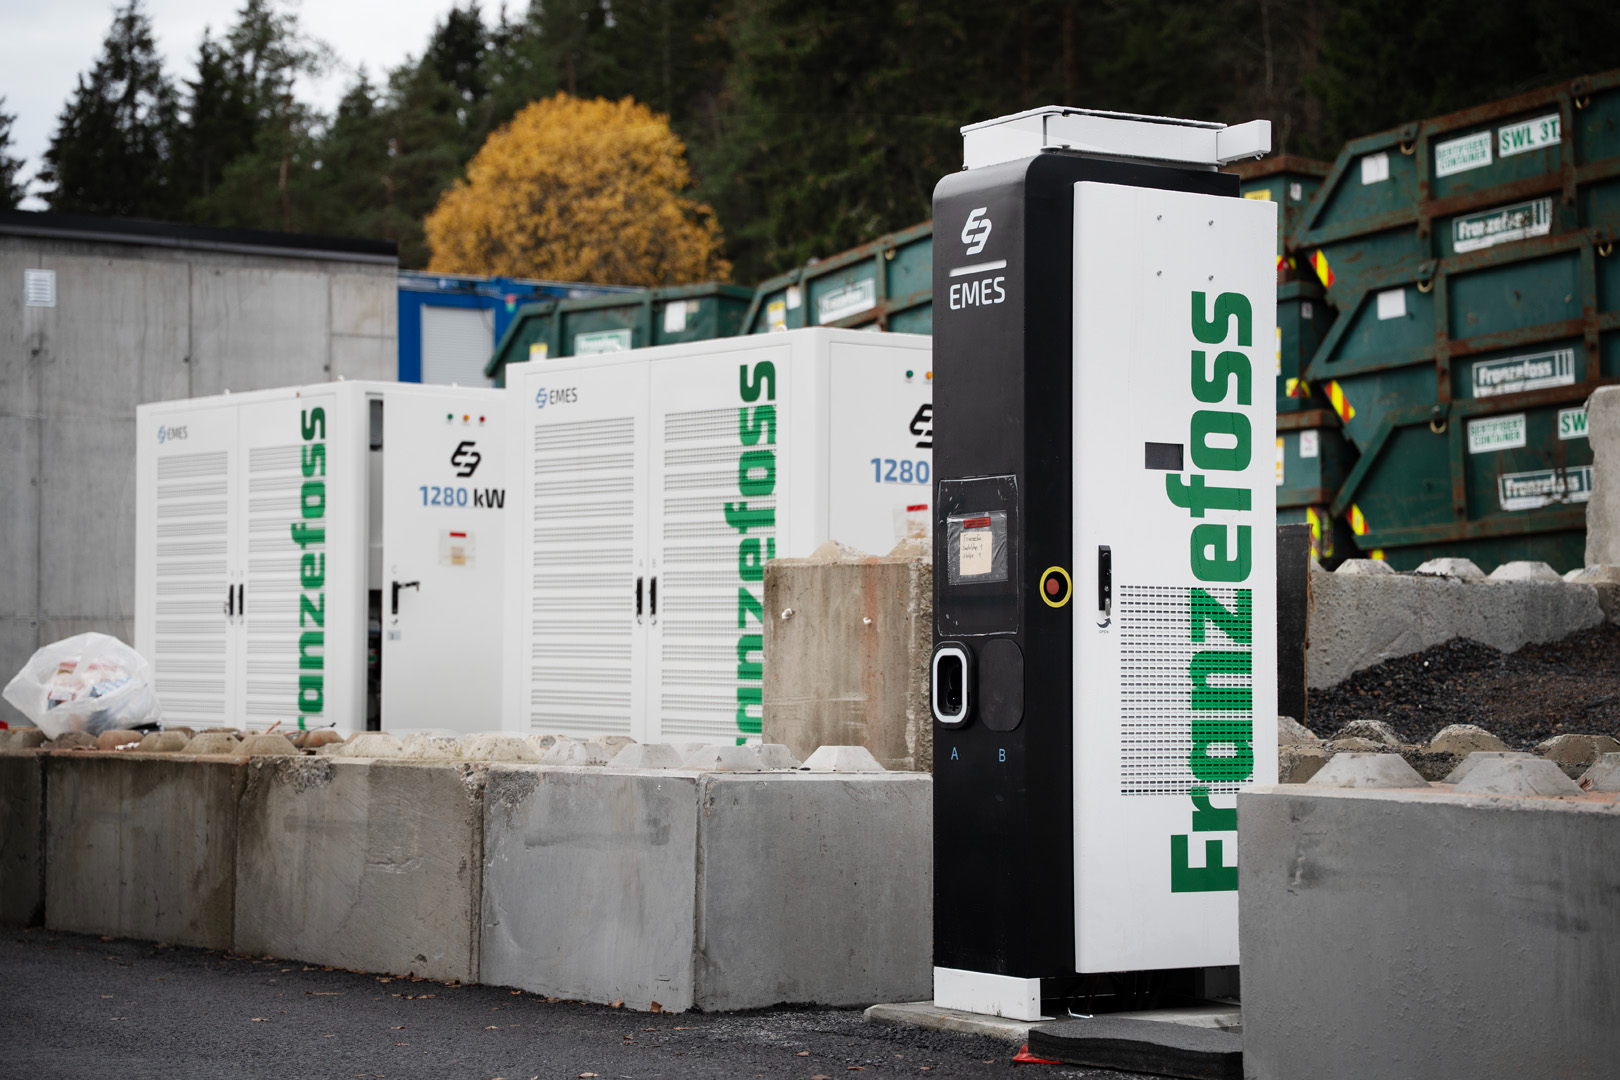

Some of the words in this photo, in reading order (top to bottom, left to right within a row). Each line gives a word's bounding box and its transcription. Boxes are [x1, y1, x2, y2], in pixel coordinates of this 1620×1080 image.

[1501, 124, 1535, 151] SWL
[949, 276, 1006, 310] EMES
[549, 387, 578, 405] EMES
[166, 425, 189, 441] EMES
[870, 458, 930, 484] 1280
[419, 485, 468, 507] 1280
[473, 488, 505, 509] kW
[723, 360, 777, 747] anzefoss
[1165, 291, 1253, 893] Franzefoss
[950, 747, 959, 760] A
[998, 748, 1006, 762] B
